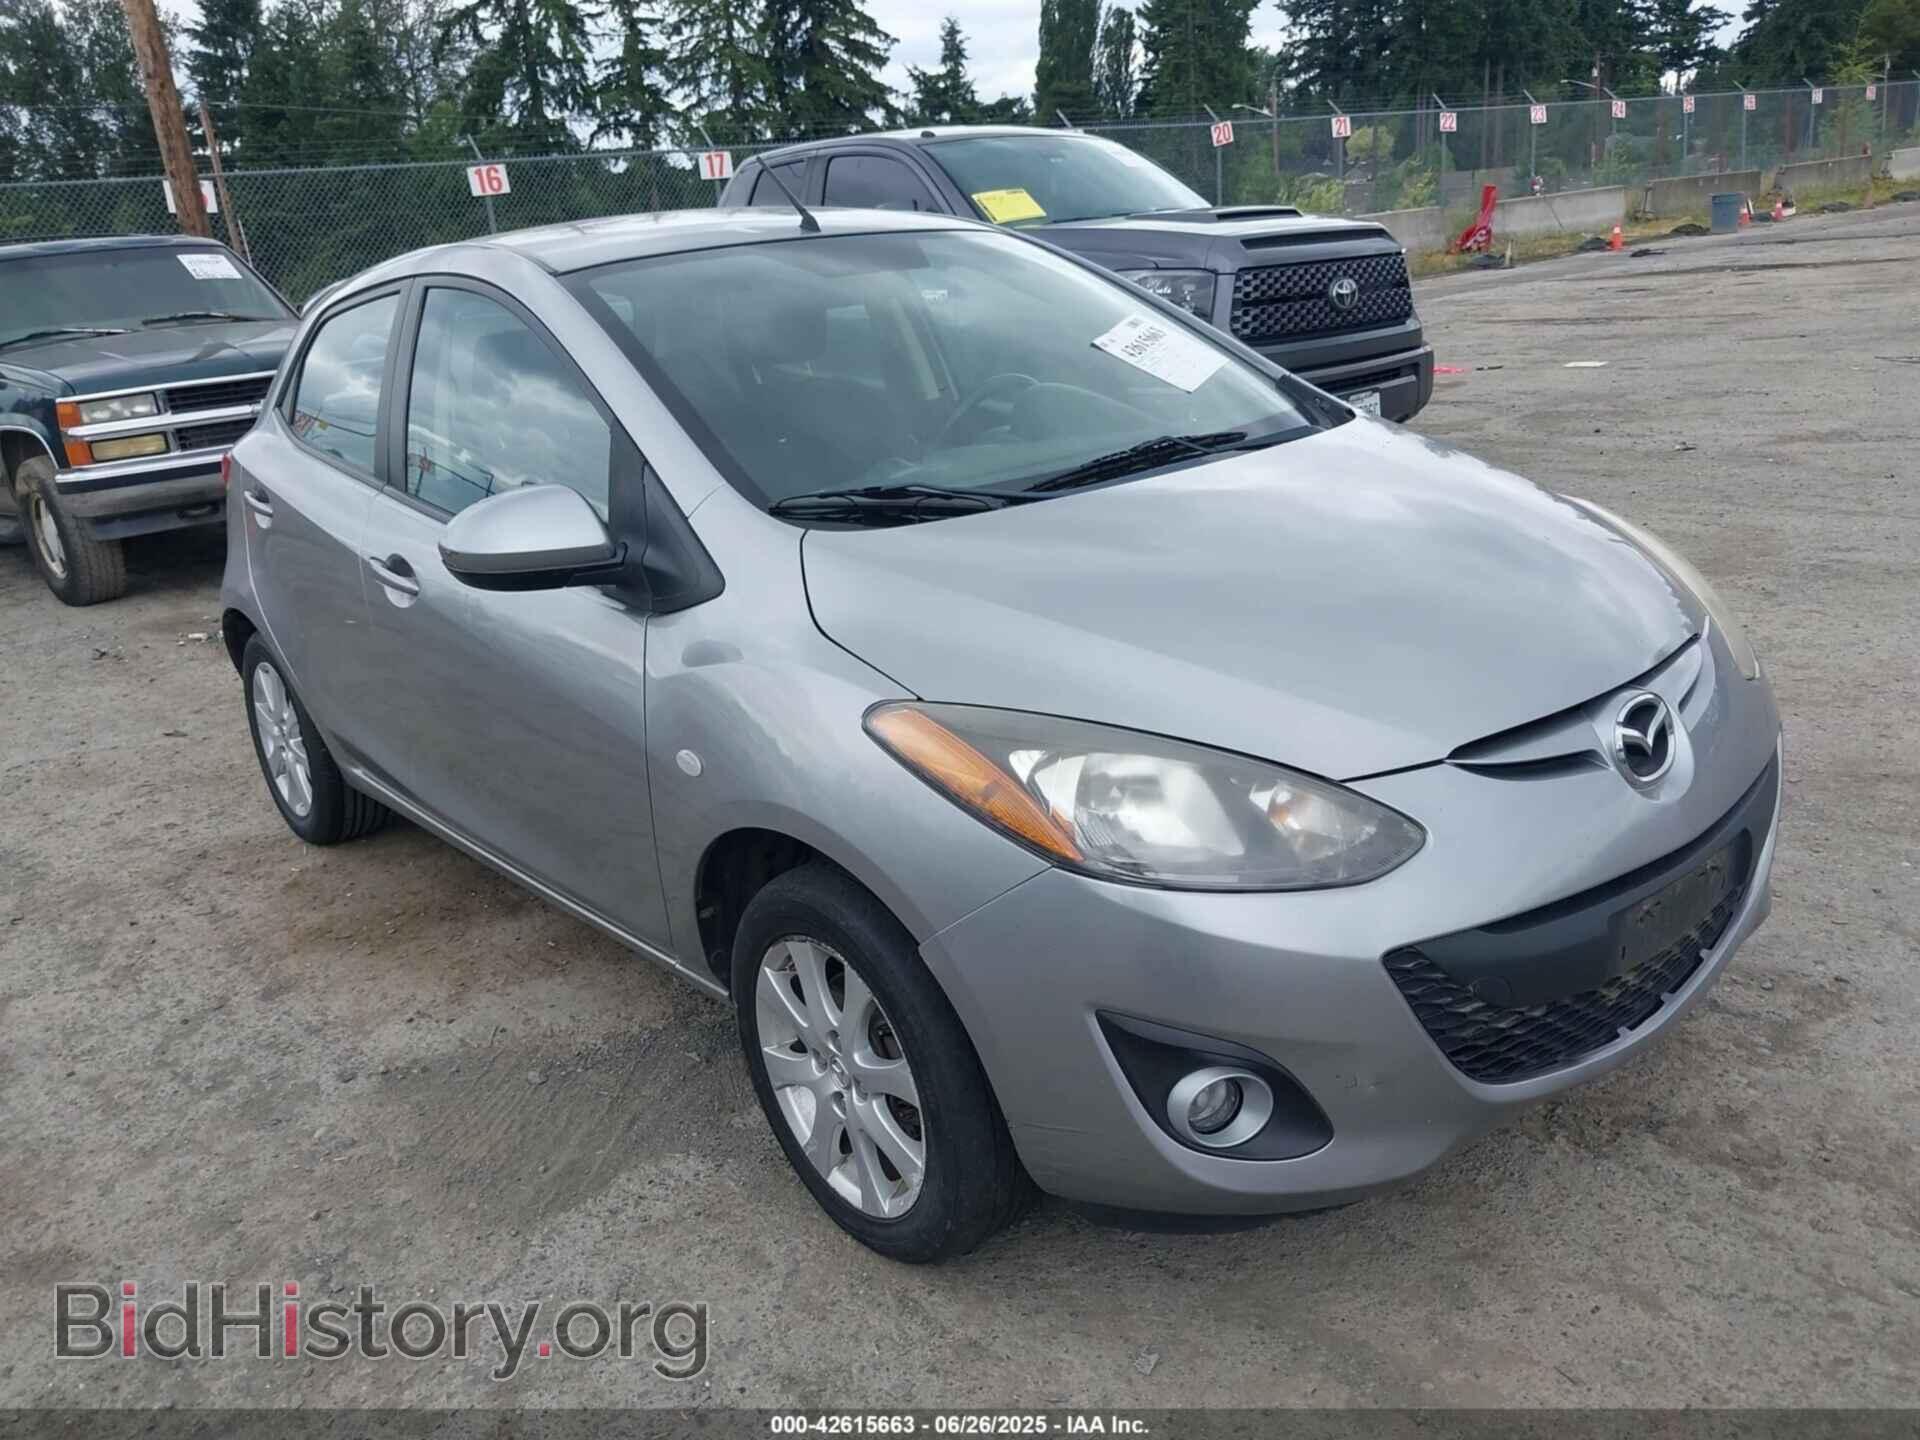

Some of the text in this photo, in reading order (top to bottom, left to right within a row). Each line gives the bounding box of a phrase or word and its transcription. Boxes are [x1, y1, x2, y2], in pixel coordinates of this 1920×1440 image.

[1533, 109, 1545, 122] 23
[1614, 102, 1624, 116] 24
[1335, 118, 1349, 136] 21
[1442, 115, 1455, 130] 22
[1214, 123, 1231, 145] 20
[705, 153, 725, 177] 17
[474, 166, 502, 193] 16
